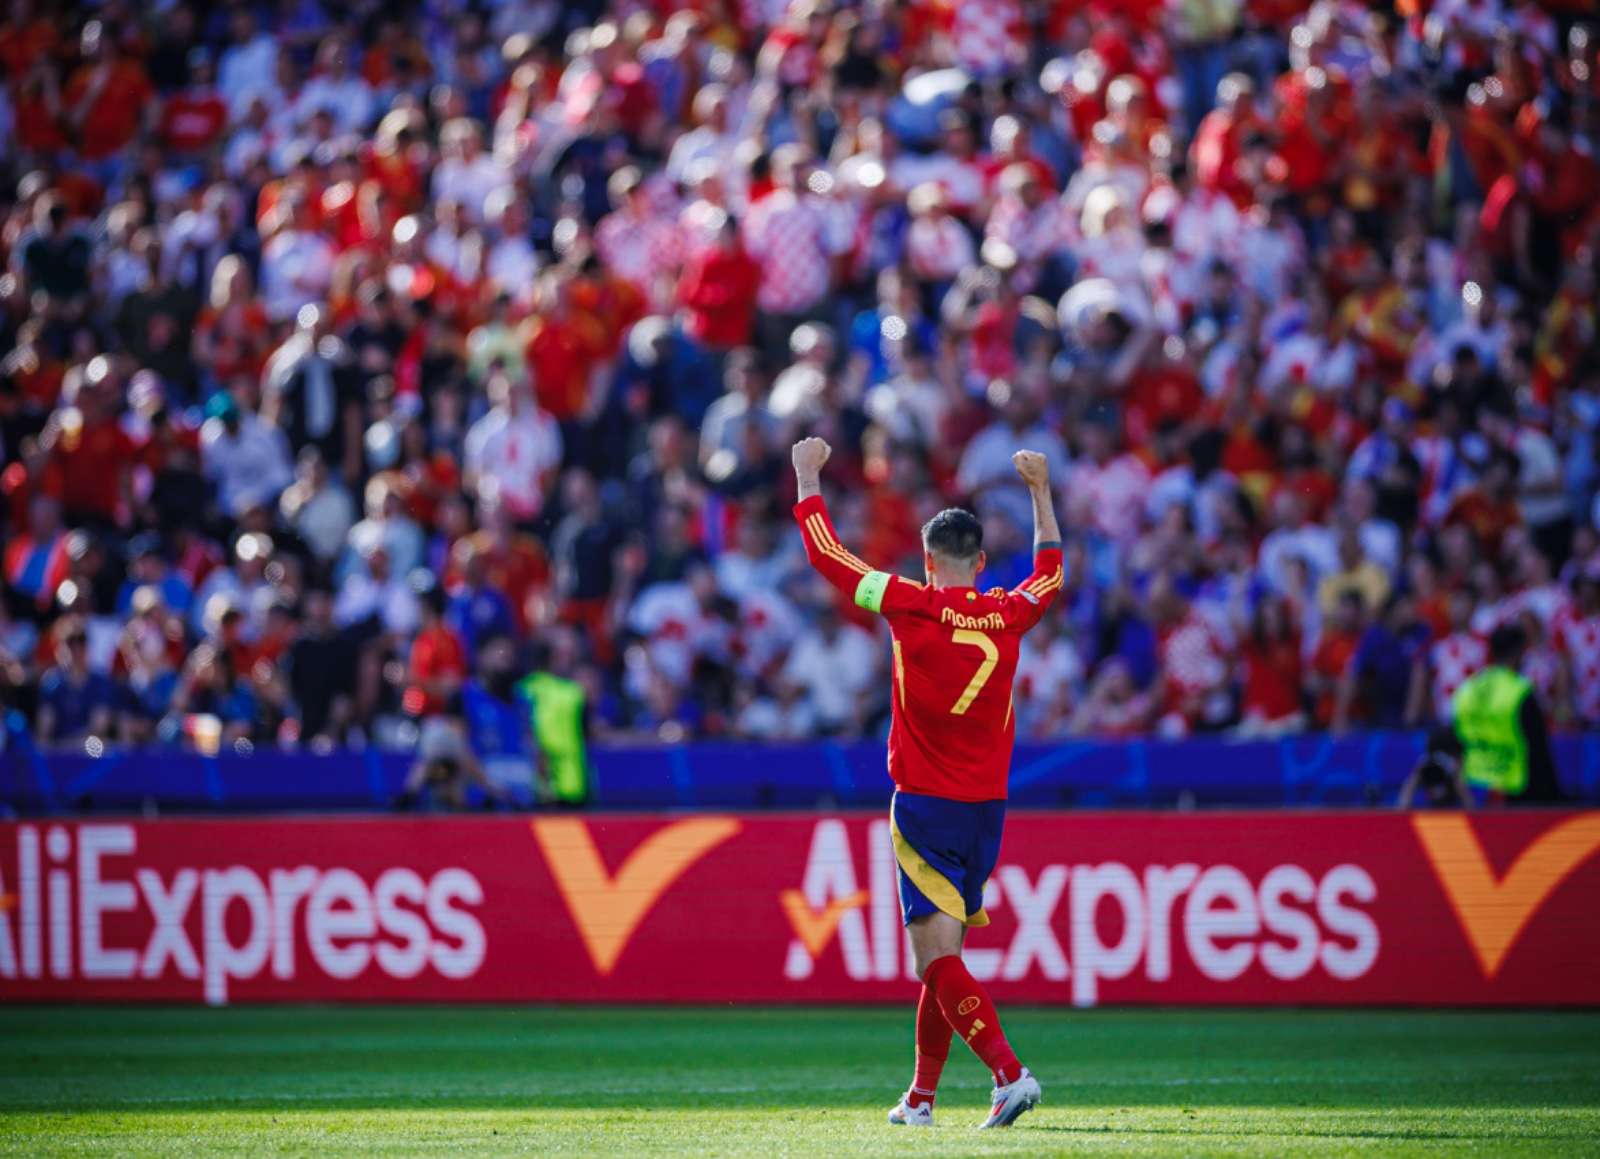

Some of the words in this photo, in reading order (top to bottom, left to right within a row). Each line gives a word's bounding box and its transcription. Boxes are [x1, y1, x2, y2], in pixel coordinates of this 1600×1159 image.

[941, 606, 1005, 629] MORATA
[950, 628, 999, 715] 7
[0, 823, 486, 1005] liExpress
[784, 818, 1380, 1006] Alxpress
